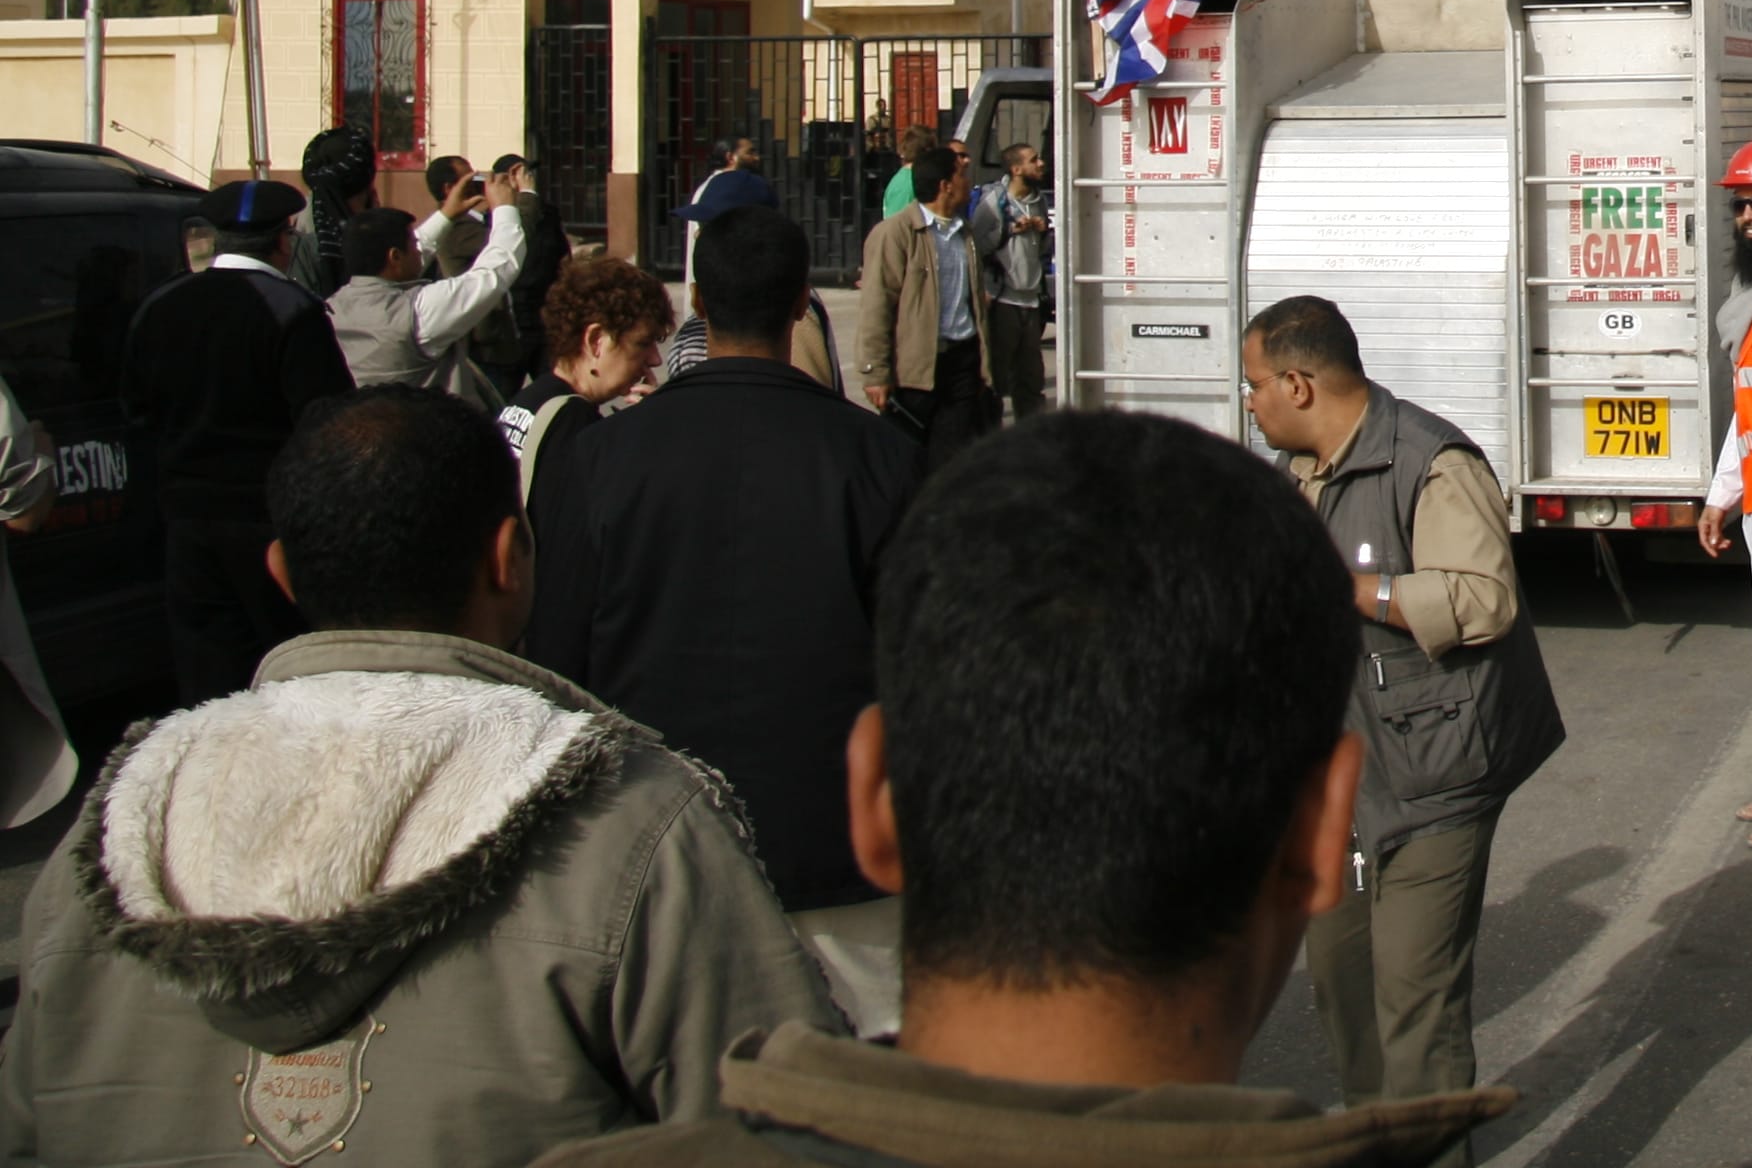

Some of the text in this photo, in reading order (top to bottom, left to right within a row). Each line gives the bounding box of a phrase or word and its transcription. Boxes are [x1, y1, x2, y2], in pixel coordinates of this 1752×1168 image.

[1121, 131, 1133, 166] URGENT
[1209, 115, 1221, 150] URGENT
[1583, 156, 1662, 169] URGENT URGENT
[1569, 199, 1581, 235] URGENT
[1582, 186, 1664, 230] FREE
[1666, 202, 1678, 238] URGENT
[1125, 213, 1136, 248] URGENT
[1569, 244, 1581, 278] URGEN
[1582, 233, 1664, 279] GAZA
[1608, 290, 1643, 302] URGENT
[1138, 326, 1202, 337] CARMICHAEL
[1604, 314, 1635, 330] GB
[1597, 399, 1657, 425] ONB
